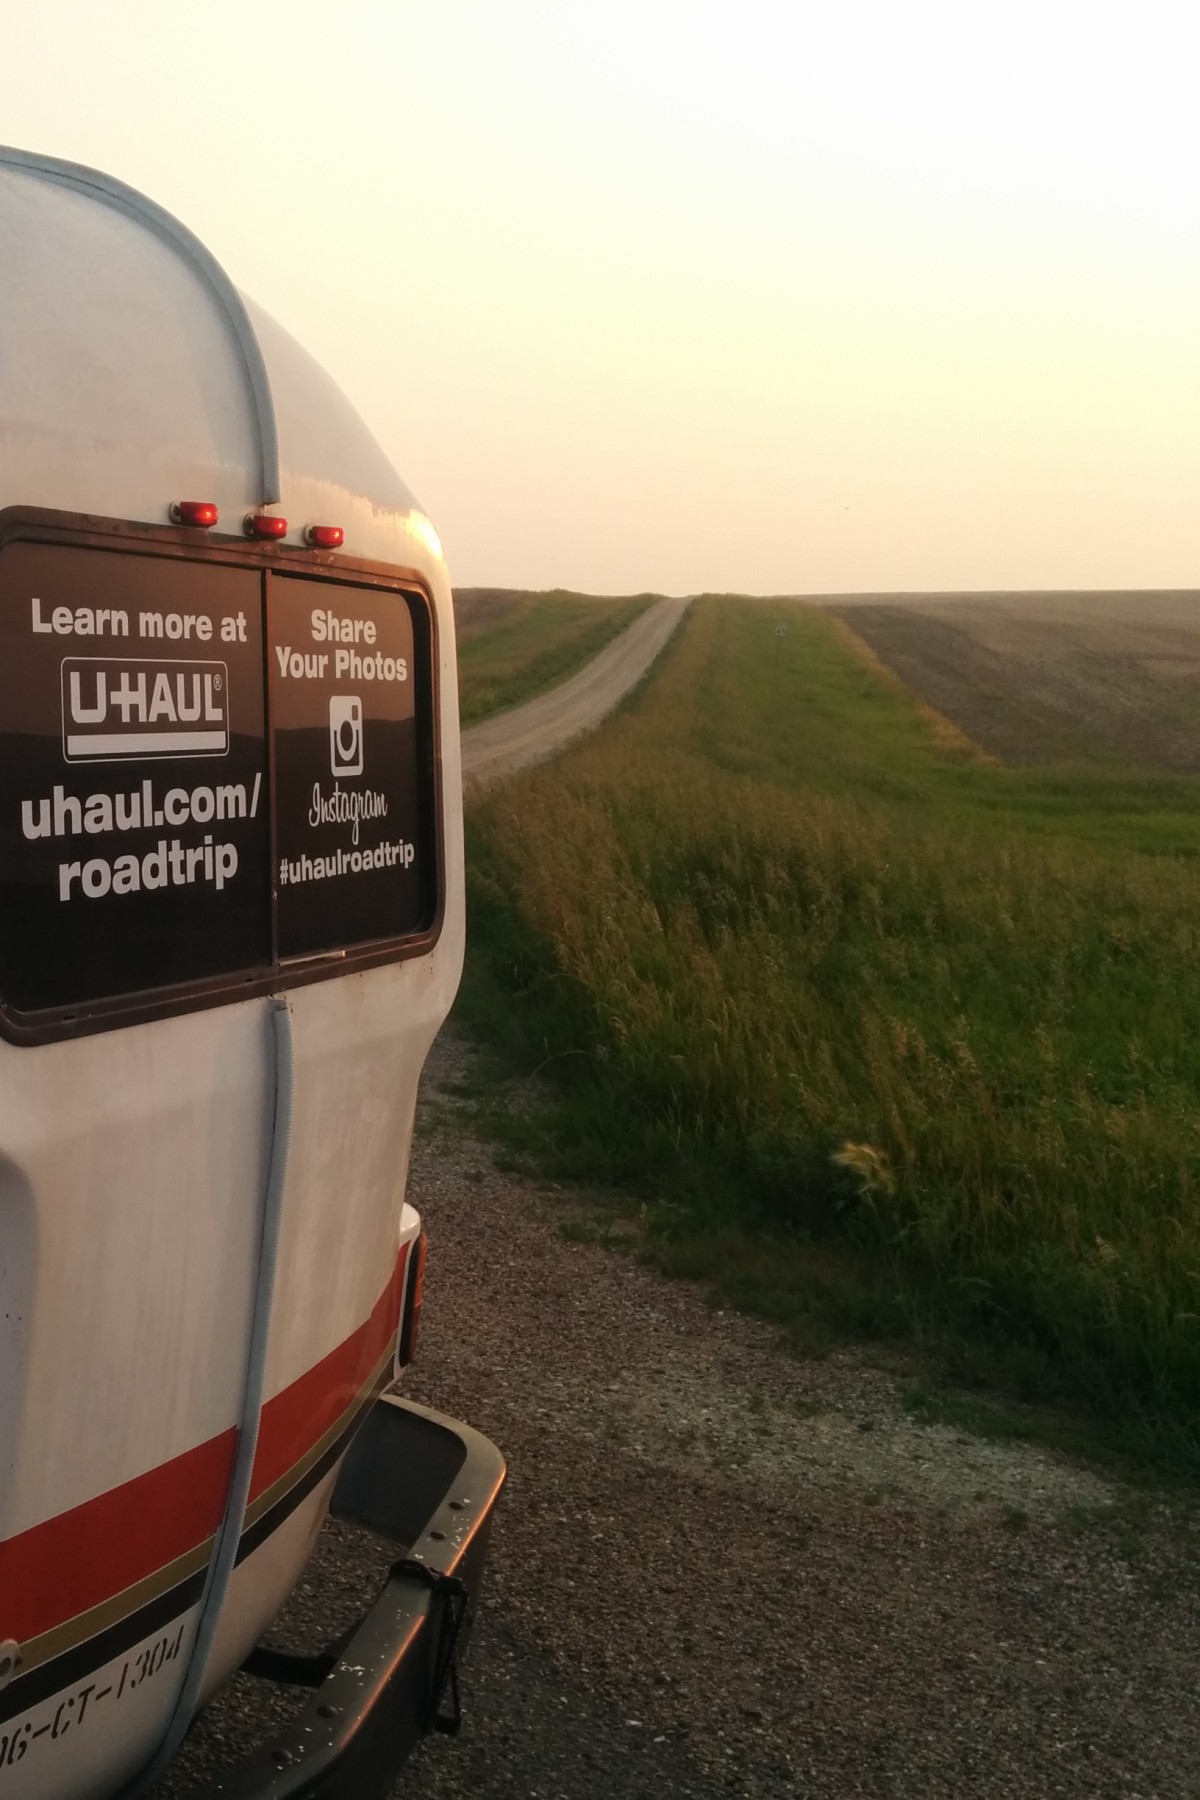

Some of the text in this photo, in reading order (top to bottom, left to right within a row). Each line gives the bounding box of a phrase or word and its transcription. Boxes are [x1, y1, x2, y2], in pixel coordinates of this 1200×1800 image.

[31, 598, 248, 642] Learn more at
[311, 608, 377, 645] Share
[275, 645, 408, 682] Your Photos
[21, 772, 262, 840] uhaul.com/
[308, 781, 388, 846] Instagram
[58, 835, 239, 902] roadtrip
[279, 838, 415, 886] #uhaulroadtrip
